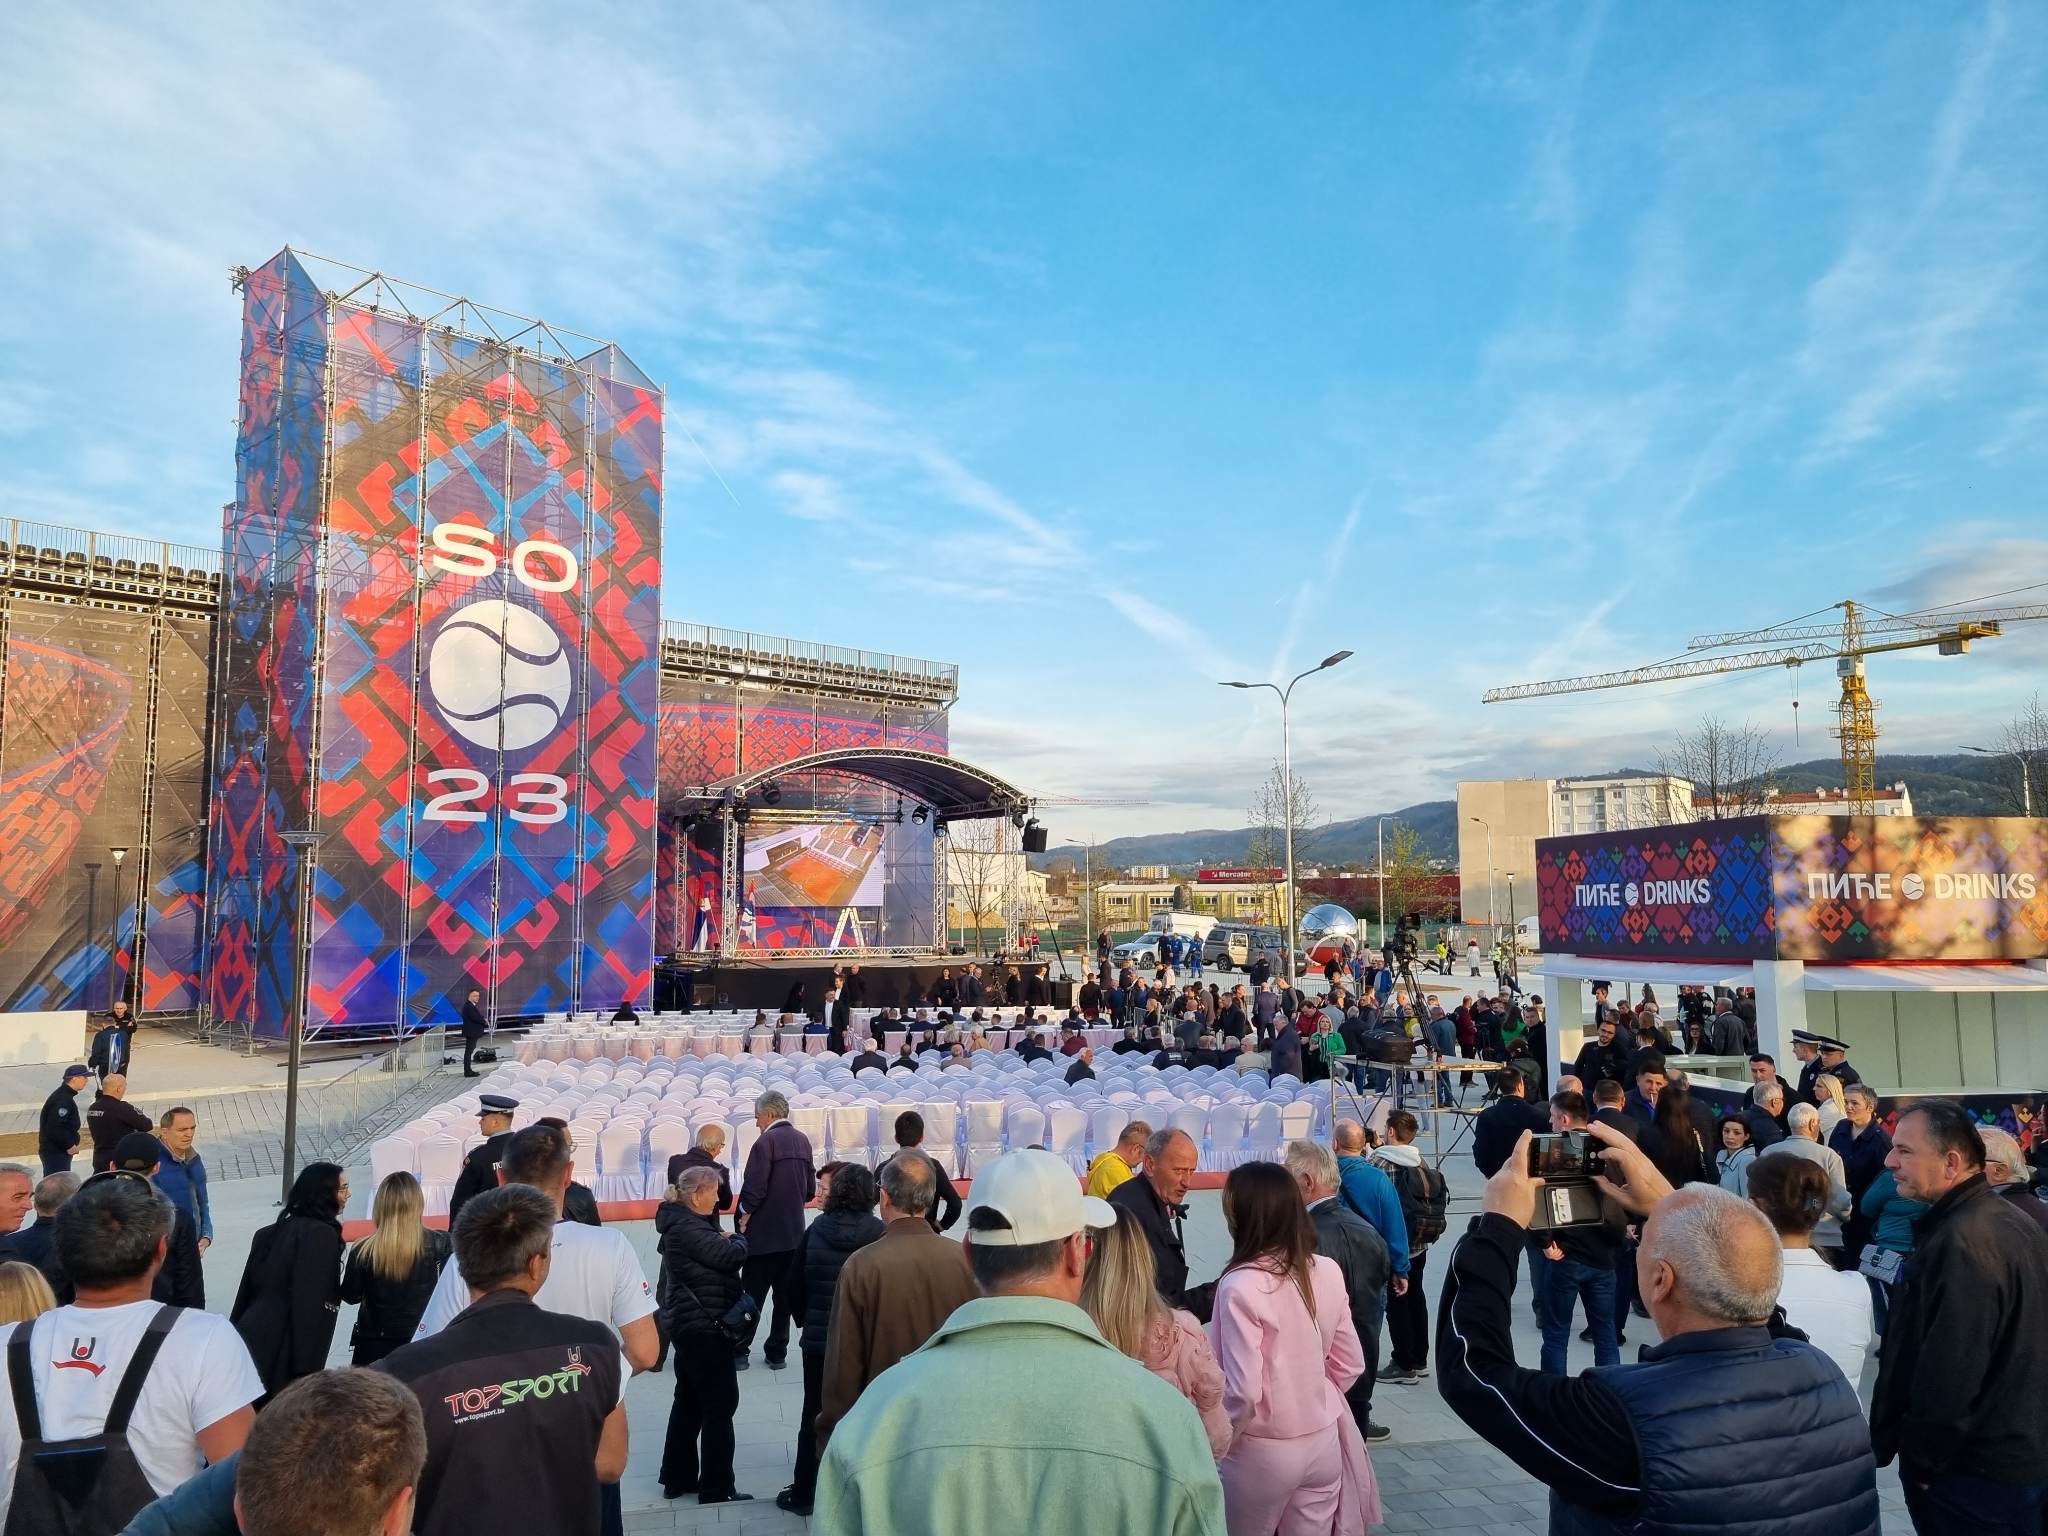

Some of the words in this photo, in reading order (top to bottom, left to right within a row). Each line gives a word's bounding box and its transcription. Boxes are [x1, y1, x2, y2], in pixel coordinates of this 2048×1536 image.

[433, 523, 578, 592] SO
[423, 769, 567, 823] 23
[1575, 883, 1620, 907] ПИЋЕ
[1644, 878, 1711, 905] DRINKS
[1807, 873, 1892, 899] ПИЋЕ
[1934, 873, 2036, 899] DRINKS
